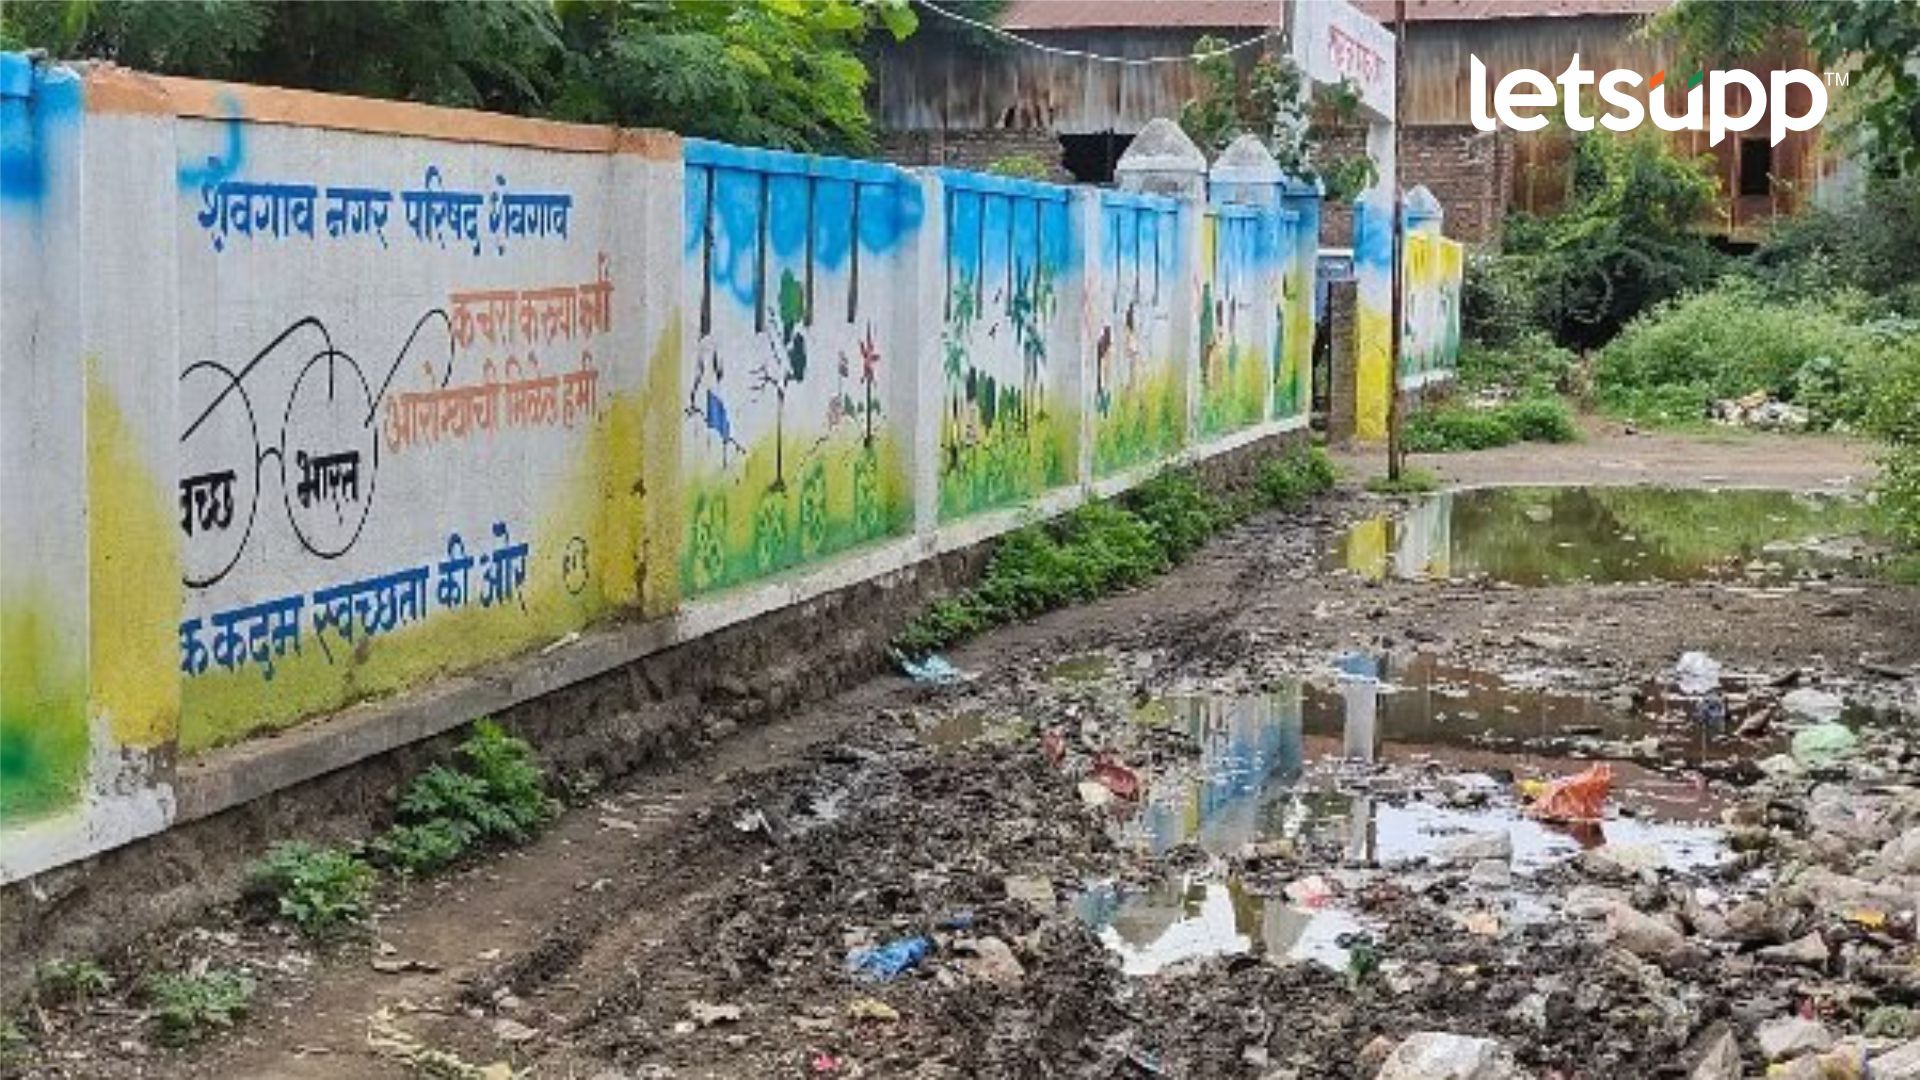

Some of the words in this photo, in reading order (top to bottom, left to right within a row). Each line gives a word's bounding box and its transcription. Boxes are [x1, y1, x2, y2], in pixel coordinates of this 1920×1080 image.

[326, 187, 394, 250] नगर
[401, 165, 484, 256] परिषद
[449, 289, 518, 348] कचरा
[297, 450, 360, 526] भारत
[211, 594, 304, 681] कदम
[313, 564, 430, 666] स्वच्छता
[438, 533, 475, 609] की
[480, 521, 529, 616] ओर
